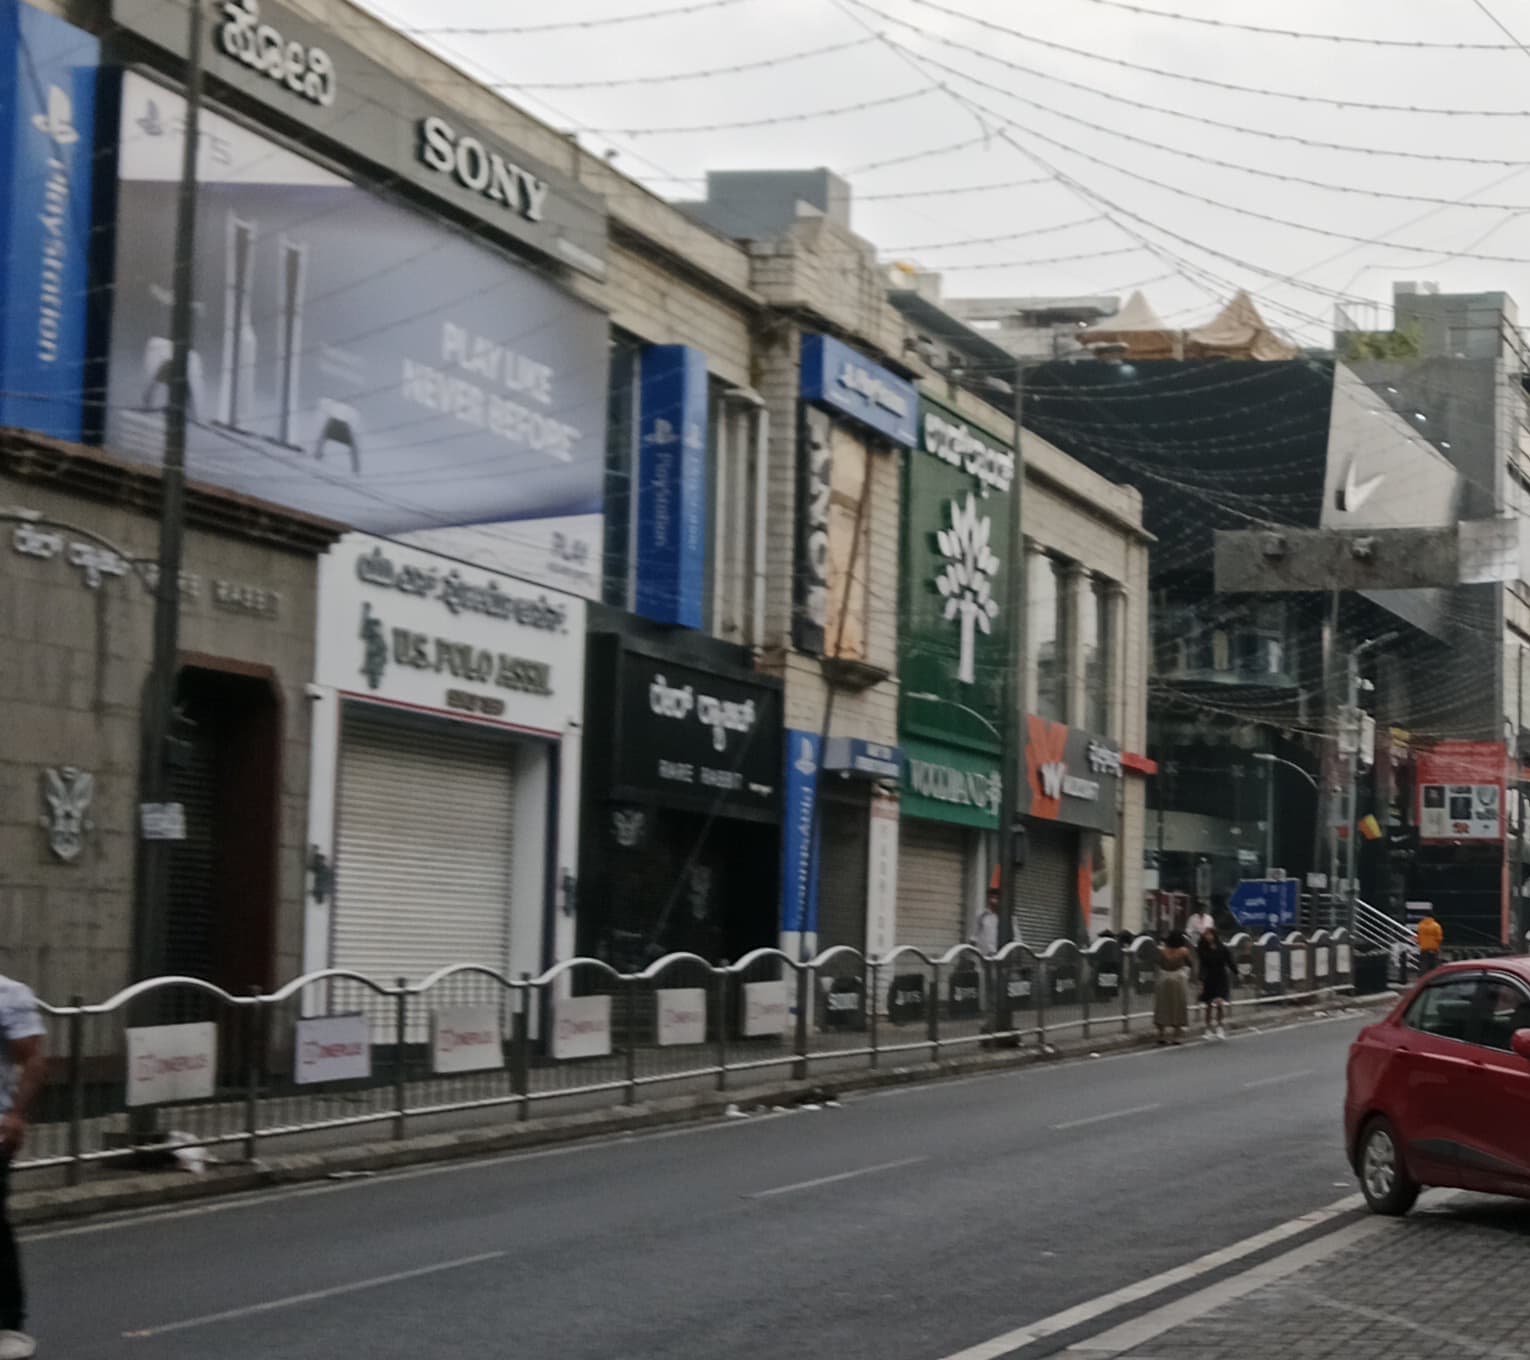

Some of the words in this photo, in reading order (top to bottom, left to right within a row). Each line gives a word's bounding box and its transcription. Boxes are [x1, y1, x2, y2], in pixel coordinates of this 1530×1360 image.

[424, 116, 548, 221] SONY
[402, 358, 485, 428] NEVER
[489, 394, 581, 463] BEFORE
[442, 321, 504, 381] PLAY
[505, 351, 555, 405] LIKE
